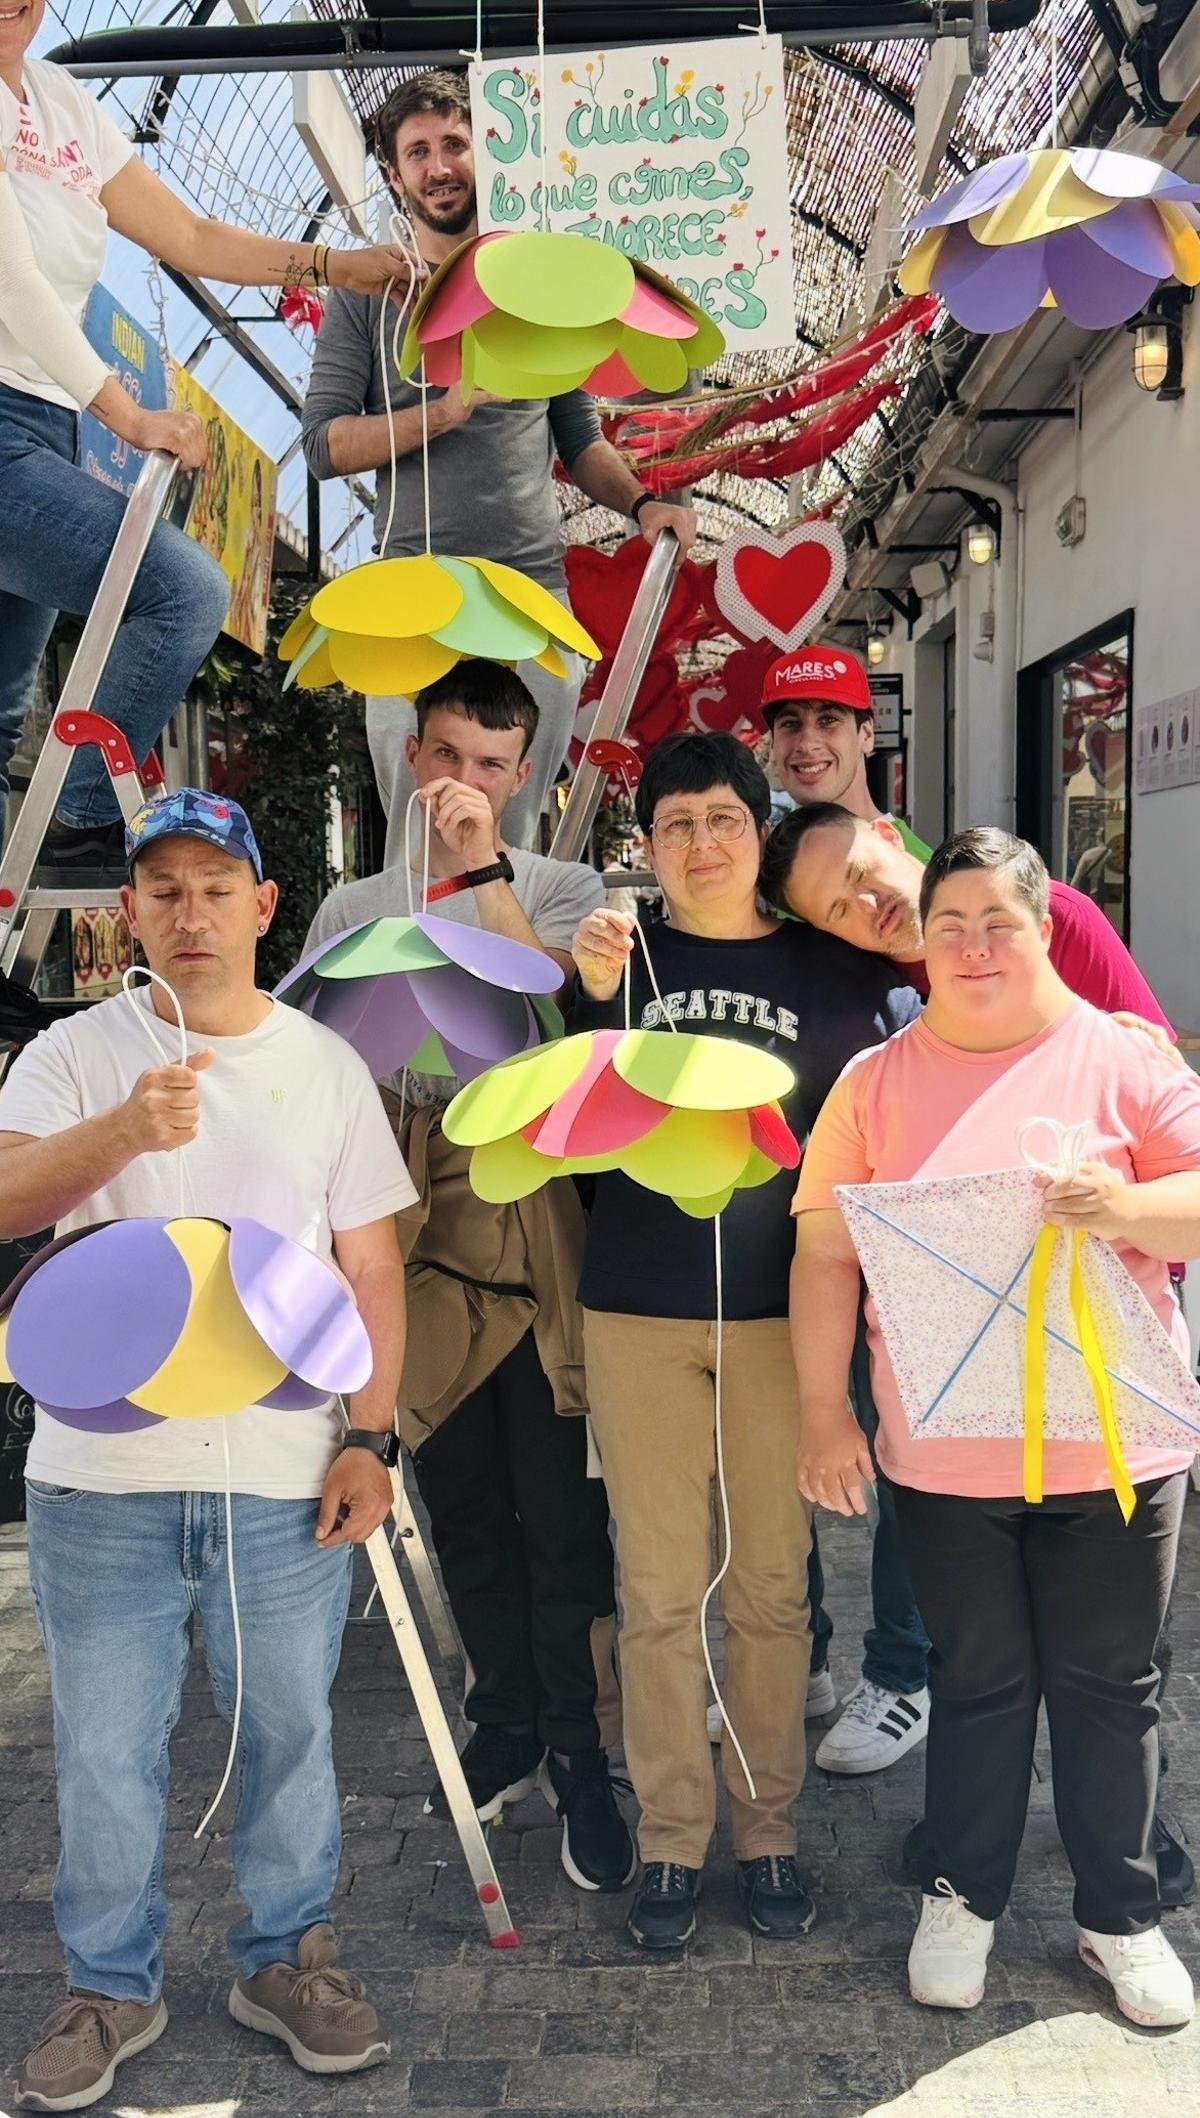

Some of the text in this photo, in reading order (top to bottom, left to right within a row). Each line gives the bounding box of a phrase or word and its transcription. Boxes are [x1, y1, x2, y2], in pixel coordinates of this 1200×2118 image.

[483, 57, 729, 163] Si cuidas
[489, 171, 526, 222] lo
[530, 172, 598, 219] que
[112, 310, 145, 375] INDIAN
[775, 661, 835, 687] MARES
[640, 989, 799, 1042] SEATTLE
